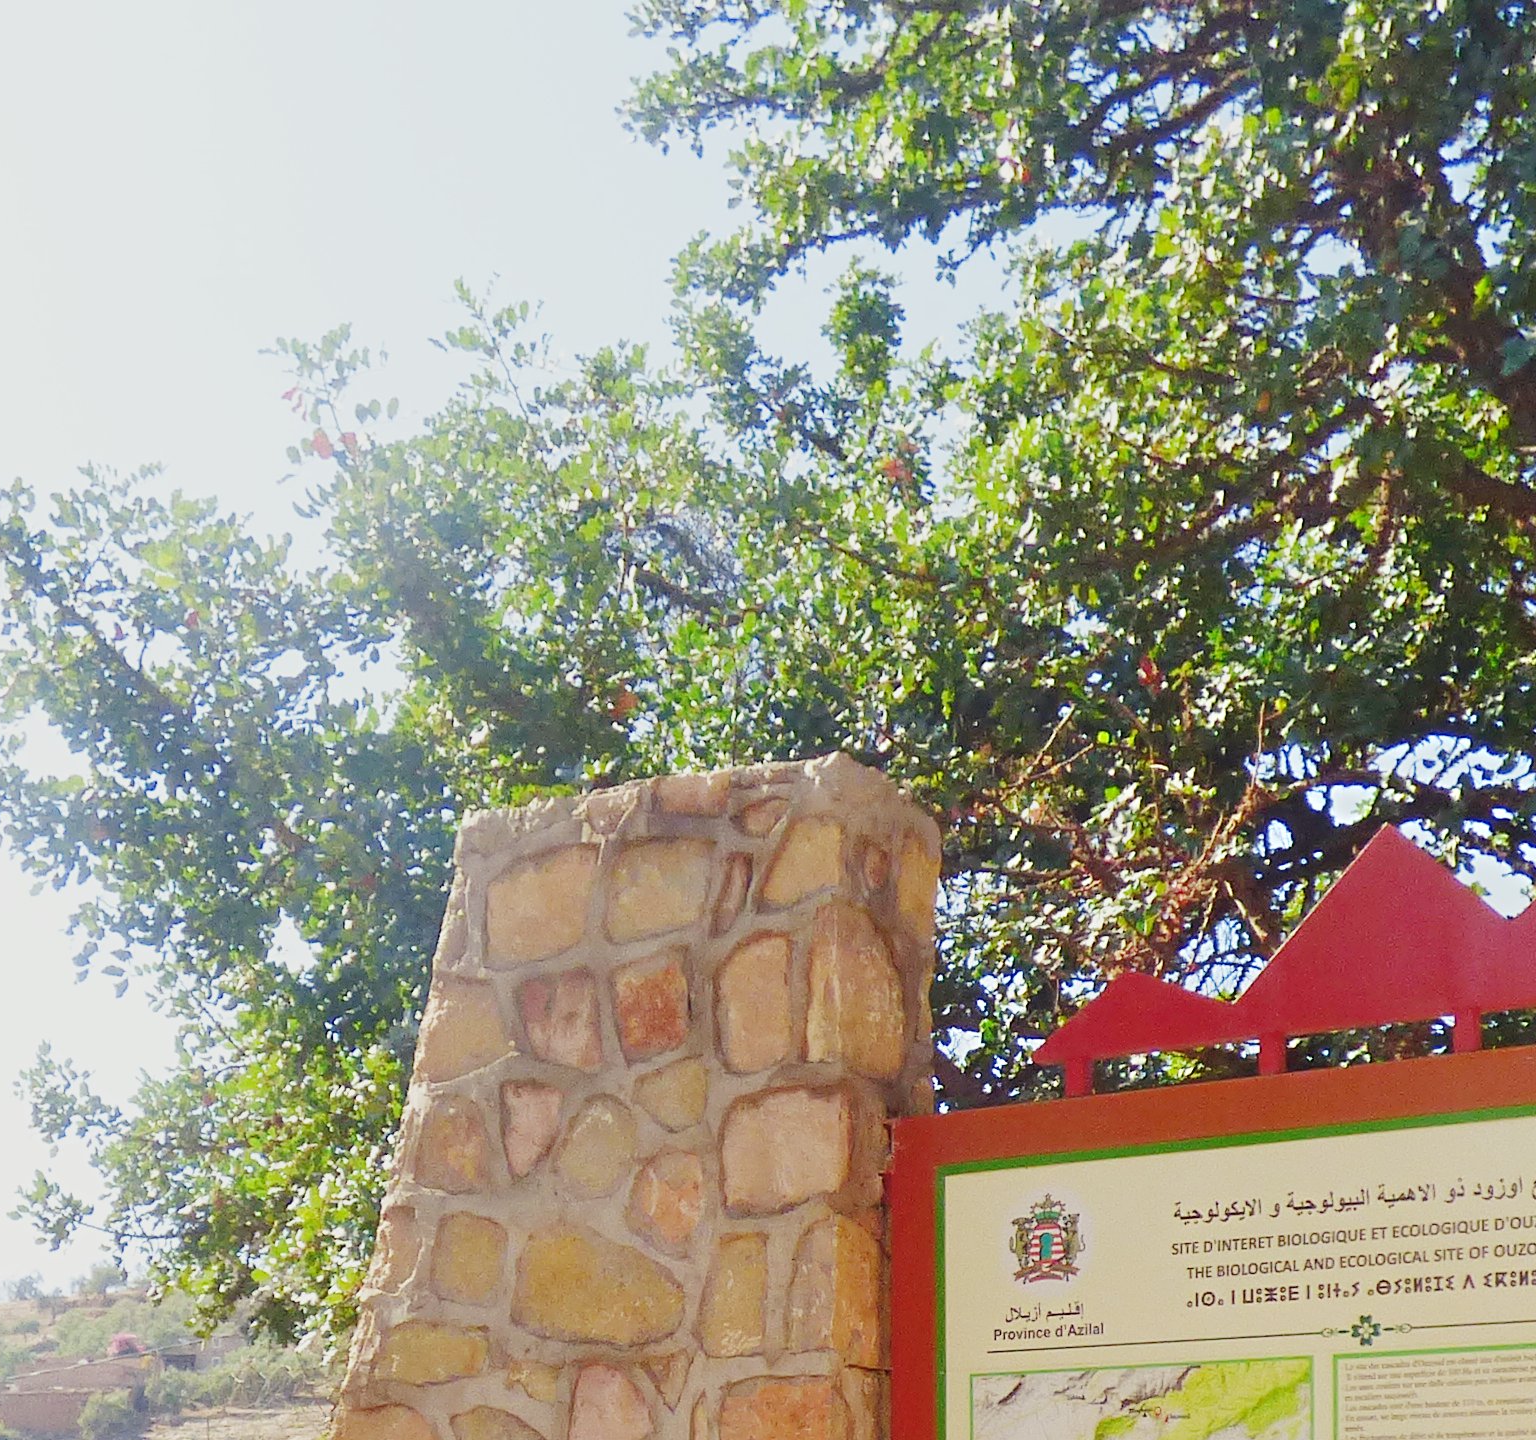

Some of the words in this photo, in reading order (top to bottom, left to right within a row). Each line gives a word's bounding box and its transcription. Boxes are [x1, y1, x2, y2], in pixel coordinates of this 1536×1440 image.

[1445, 1177, 1465, 1203] ذو
[1473, 1177, 1523, 1200] اوزود
[1269, 1203, 1280, 1218] و
[1172, 1241, 1199, 1255] SITE
[1203, 1236, 1273, 1252] D'INTERET
[1278, 1228, 1366, 1247] BIOLOGIQUE
[1372, 1227, 1387, 1240] ET
[1392, 1219, 1489, 1239] ECOLOGIQUE
[1187, 1266, 1212, 1279] THE
[1217, 1259, 1299, 1277] BIOLOGICAL
[1304, 1257, 1335, 1271] AND
[1340, 1250, 1429, 1268] ECOLOGICAL
[1434, 1248, 1464, 1262] SITE
[1469, 1245, 1489, 1259] OF
[994, 1328, 1051, 1341] Province
[1055, 1323, 1104, 1337] d'Azilal
